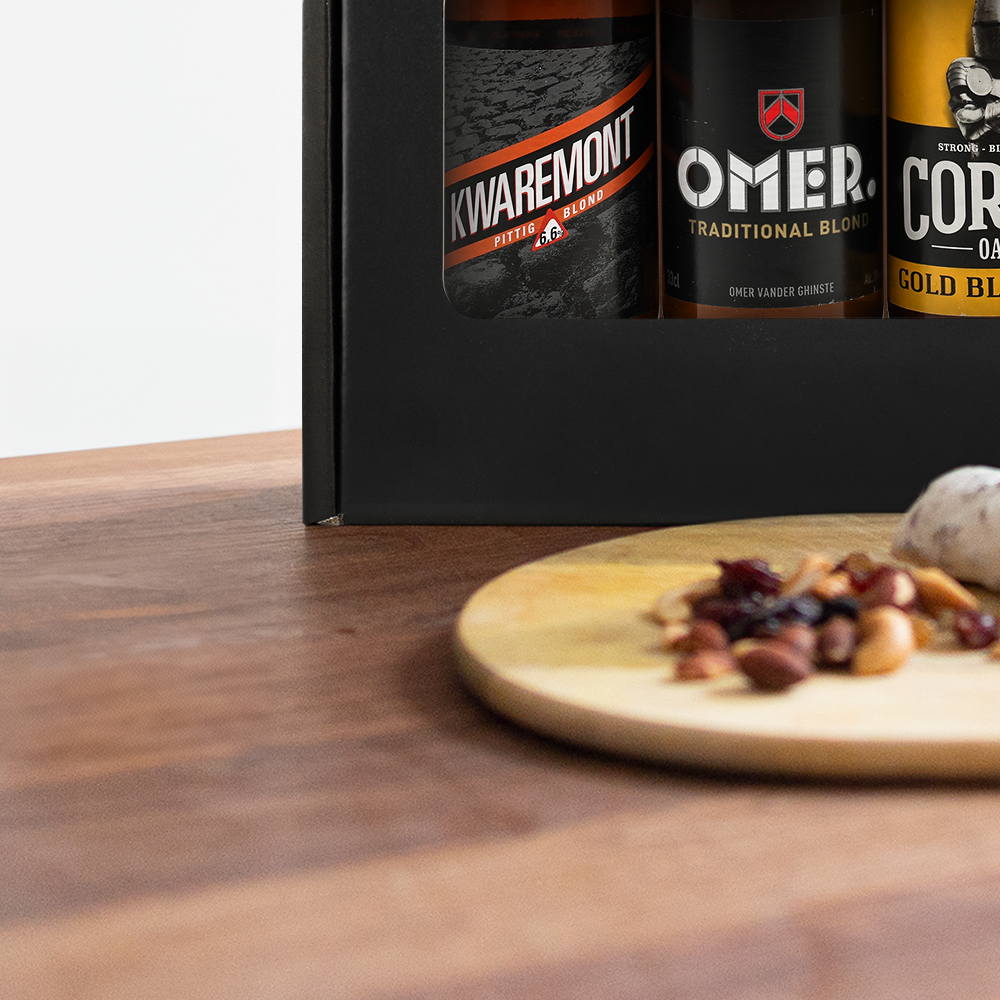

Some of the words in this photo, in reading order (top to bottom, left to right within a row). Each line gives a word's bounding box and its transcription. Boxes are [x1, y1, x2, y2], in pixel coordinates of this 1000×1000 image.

[938, 142, 979, 153] STRONG
[451, 105, 635, 243] KWAREMONT
[563, 189, 604, 219] BLOND
[494, 222, 535, 247] PITTIG
[688, 218, 813, 239] TRADITIONAL
[819, 212, 869, 236] BLOND
[729, 286, 755, 298] OMER
[757, 286, 795, 298] VANDER
[797, 282, 835, 297] GHINSTE
[899, 267, 956, 297] GOLD
